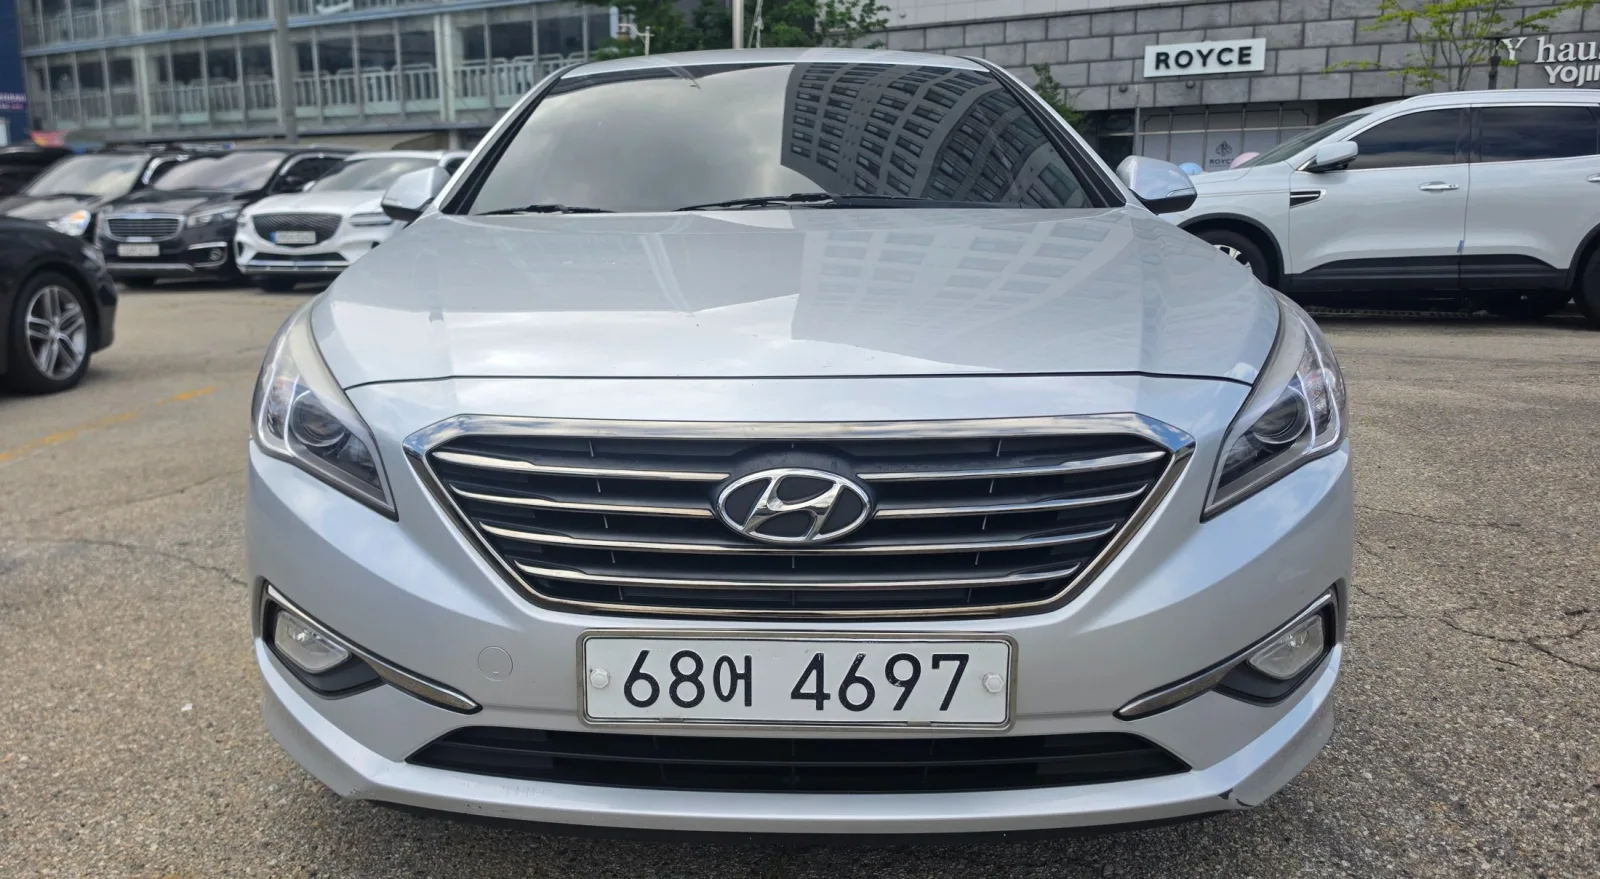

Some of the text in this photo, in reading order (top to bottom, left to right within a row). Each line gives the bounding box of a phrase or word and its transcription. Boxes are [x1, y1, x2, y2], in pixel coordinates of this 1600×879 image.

[1155, 46, 1252, 70] ROYCE
[1501, 36, 1600, 63] Y hau
[623, 650, 969, 712] 68어 4697
